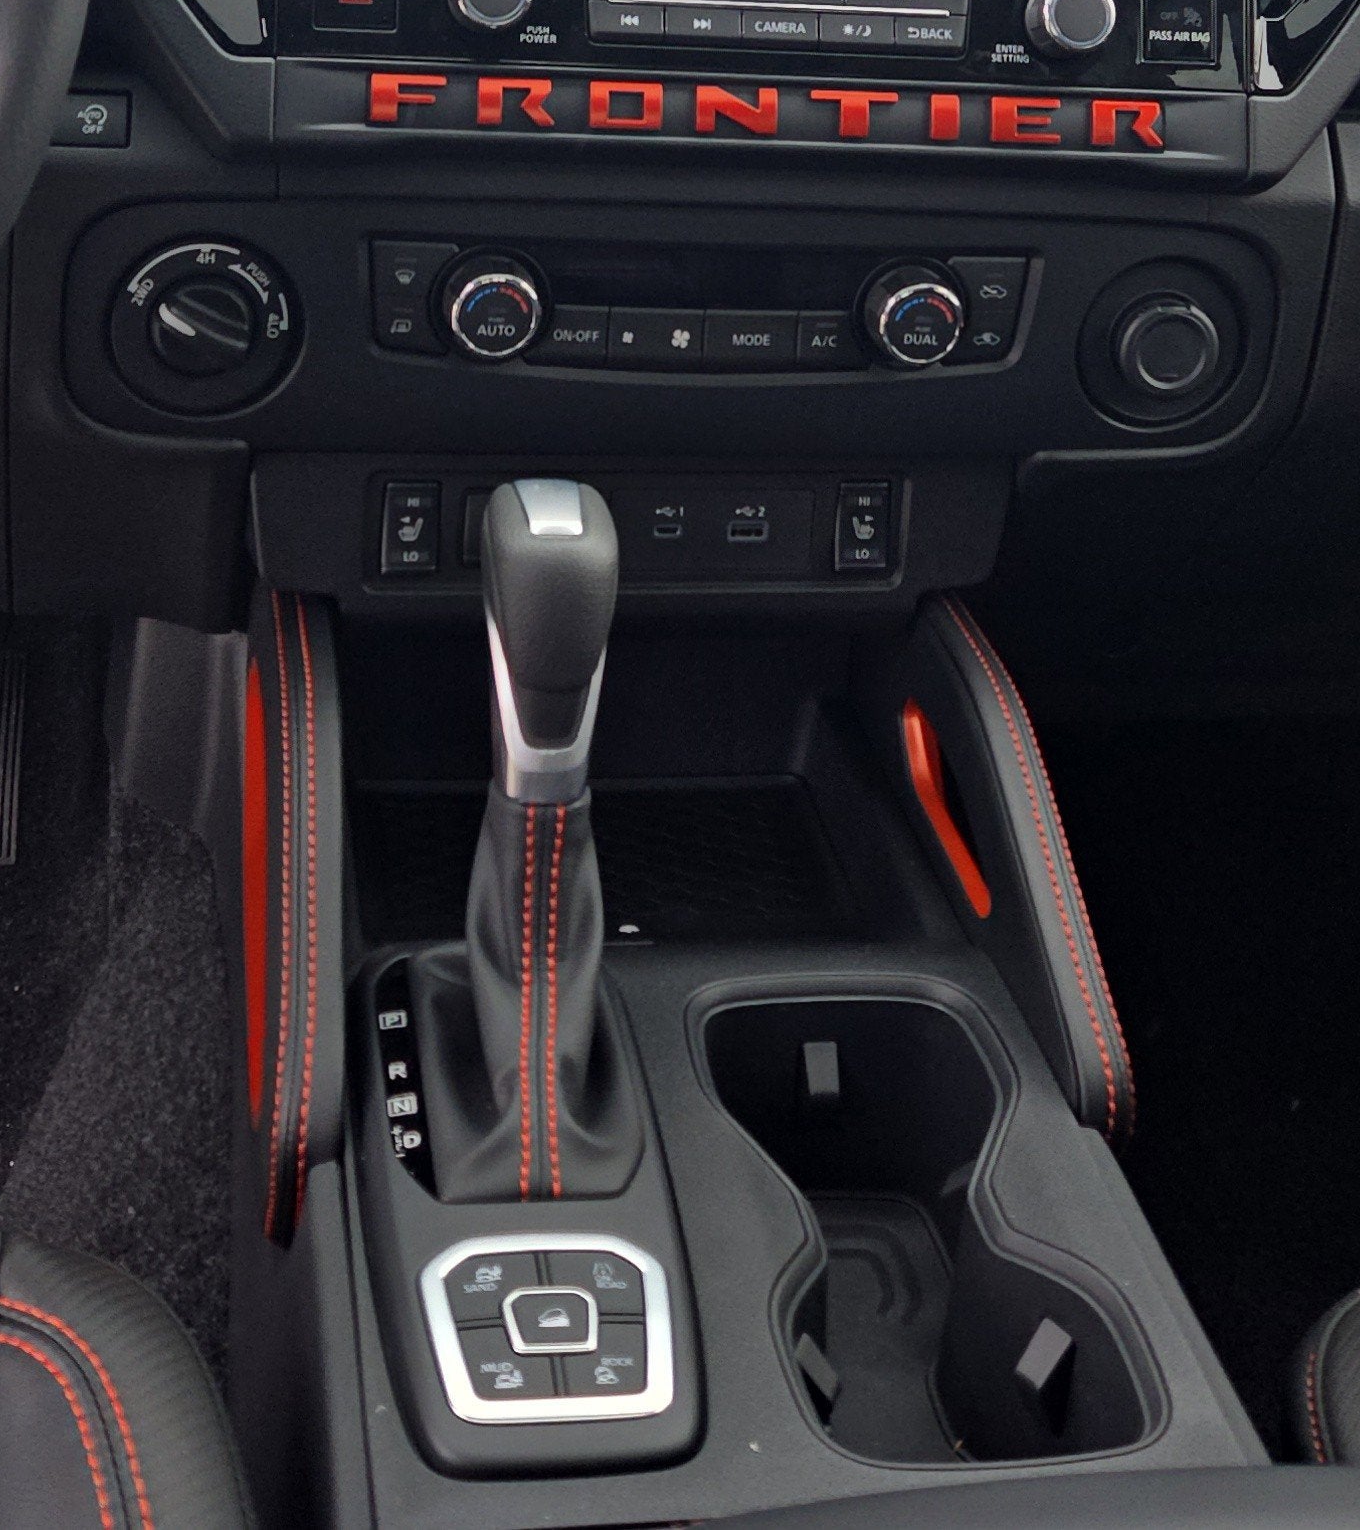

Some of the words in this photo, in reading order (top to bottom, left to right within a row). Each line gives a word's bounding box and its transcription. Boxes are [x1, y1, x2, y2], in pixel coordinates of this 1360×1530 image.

[525, 25, 551, 35] PUSH
[754, 20, 807, 35] CAMERA
[920, 27, 953, 40] BACK
[519, 33, 558, 45] POWER
[1148, 29, 1173, 42] PASS
[1173, 31, 1191, 42] AIR
[1191, 31, 1211, 43] BAG
[995, 43, 1025, 54] ENTER
[991, 51, 1030, 64] SETTING
[368, 72, 1164, 149] FRONTIER
[196, 252, 216, 265] 4H
[245, 262, 271, 288] PUSH
[130, 278, 154, 307] 2WD
[476, 324, 516, 338] AUTO
[732, 333, 771, 347] MODE
[811, 334, 838, 348] A/C
[903, 332, 939, 346] DUAL
[406, 496, 420, 508] HI
[857, 495, 871, 506] HI
[402, 550, 419, 562] LO
[854, 548, 871, 560] LO
[388, 1060, 408, 1080] R
[403, 1129, 422, 1149] D
